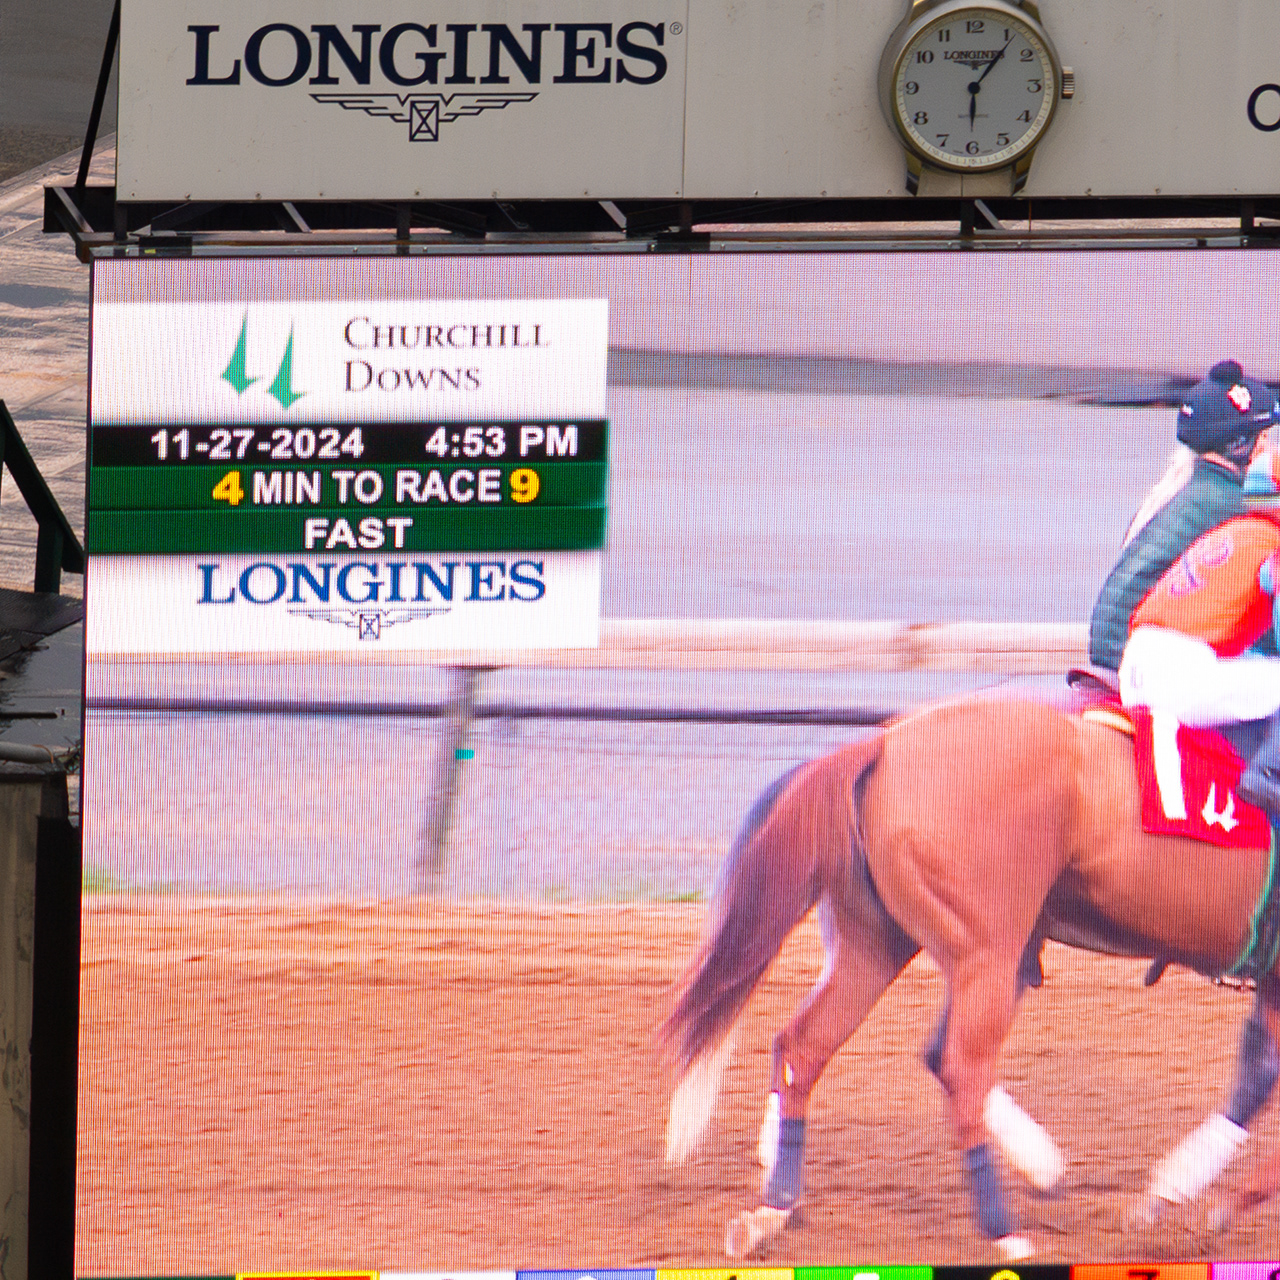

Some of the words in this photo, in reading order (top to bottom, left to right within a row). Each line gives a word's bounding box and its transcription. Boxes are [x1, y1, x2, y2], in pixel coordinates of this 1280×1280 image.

[966, 21, 985, 34] 12
[938, 29, 950, 42] 11
[916, 50, 935, 64] 10
[944, 50, 1005, 60] LONGINES
[1019, 49, 1033, 63] 2
[905, 81, 920, 95] 9
[1026, 79, 1042, 93] 3
[913, 111, 929, 125] 8
[1016, 110, 1032, 123] 4
[936, 134, 950, 147] 7
[996, 132, 1010, 146] 5
[965, 141, 980, 155] 6
[344, 316, 552, 351] CHURCHILL
[344, 360, 482, 393] DOWNS
[151, 427, 364, 461] 11-27-2024
[425, 426, 506, 458] 4:53
[519, 425, 579, 457] PM
[212, 472, 244, 505] 4
[252, 471, 321, 505] MIN
[332, 470, 384, 503] TO
[396, 469, 502, 503] RACE
[509, 468, 541, 502] 9
[304, 517, 413, 549] FAST
[197, 560, 547, 605] LONGINES
